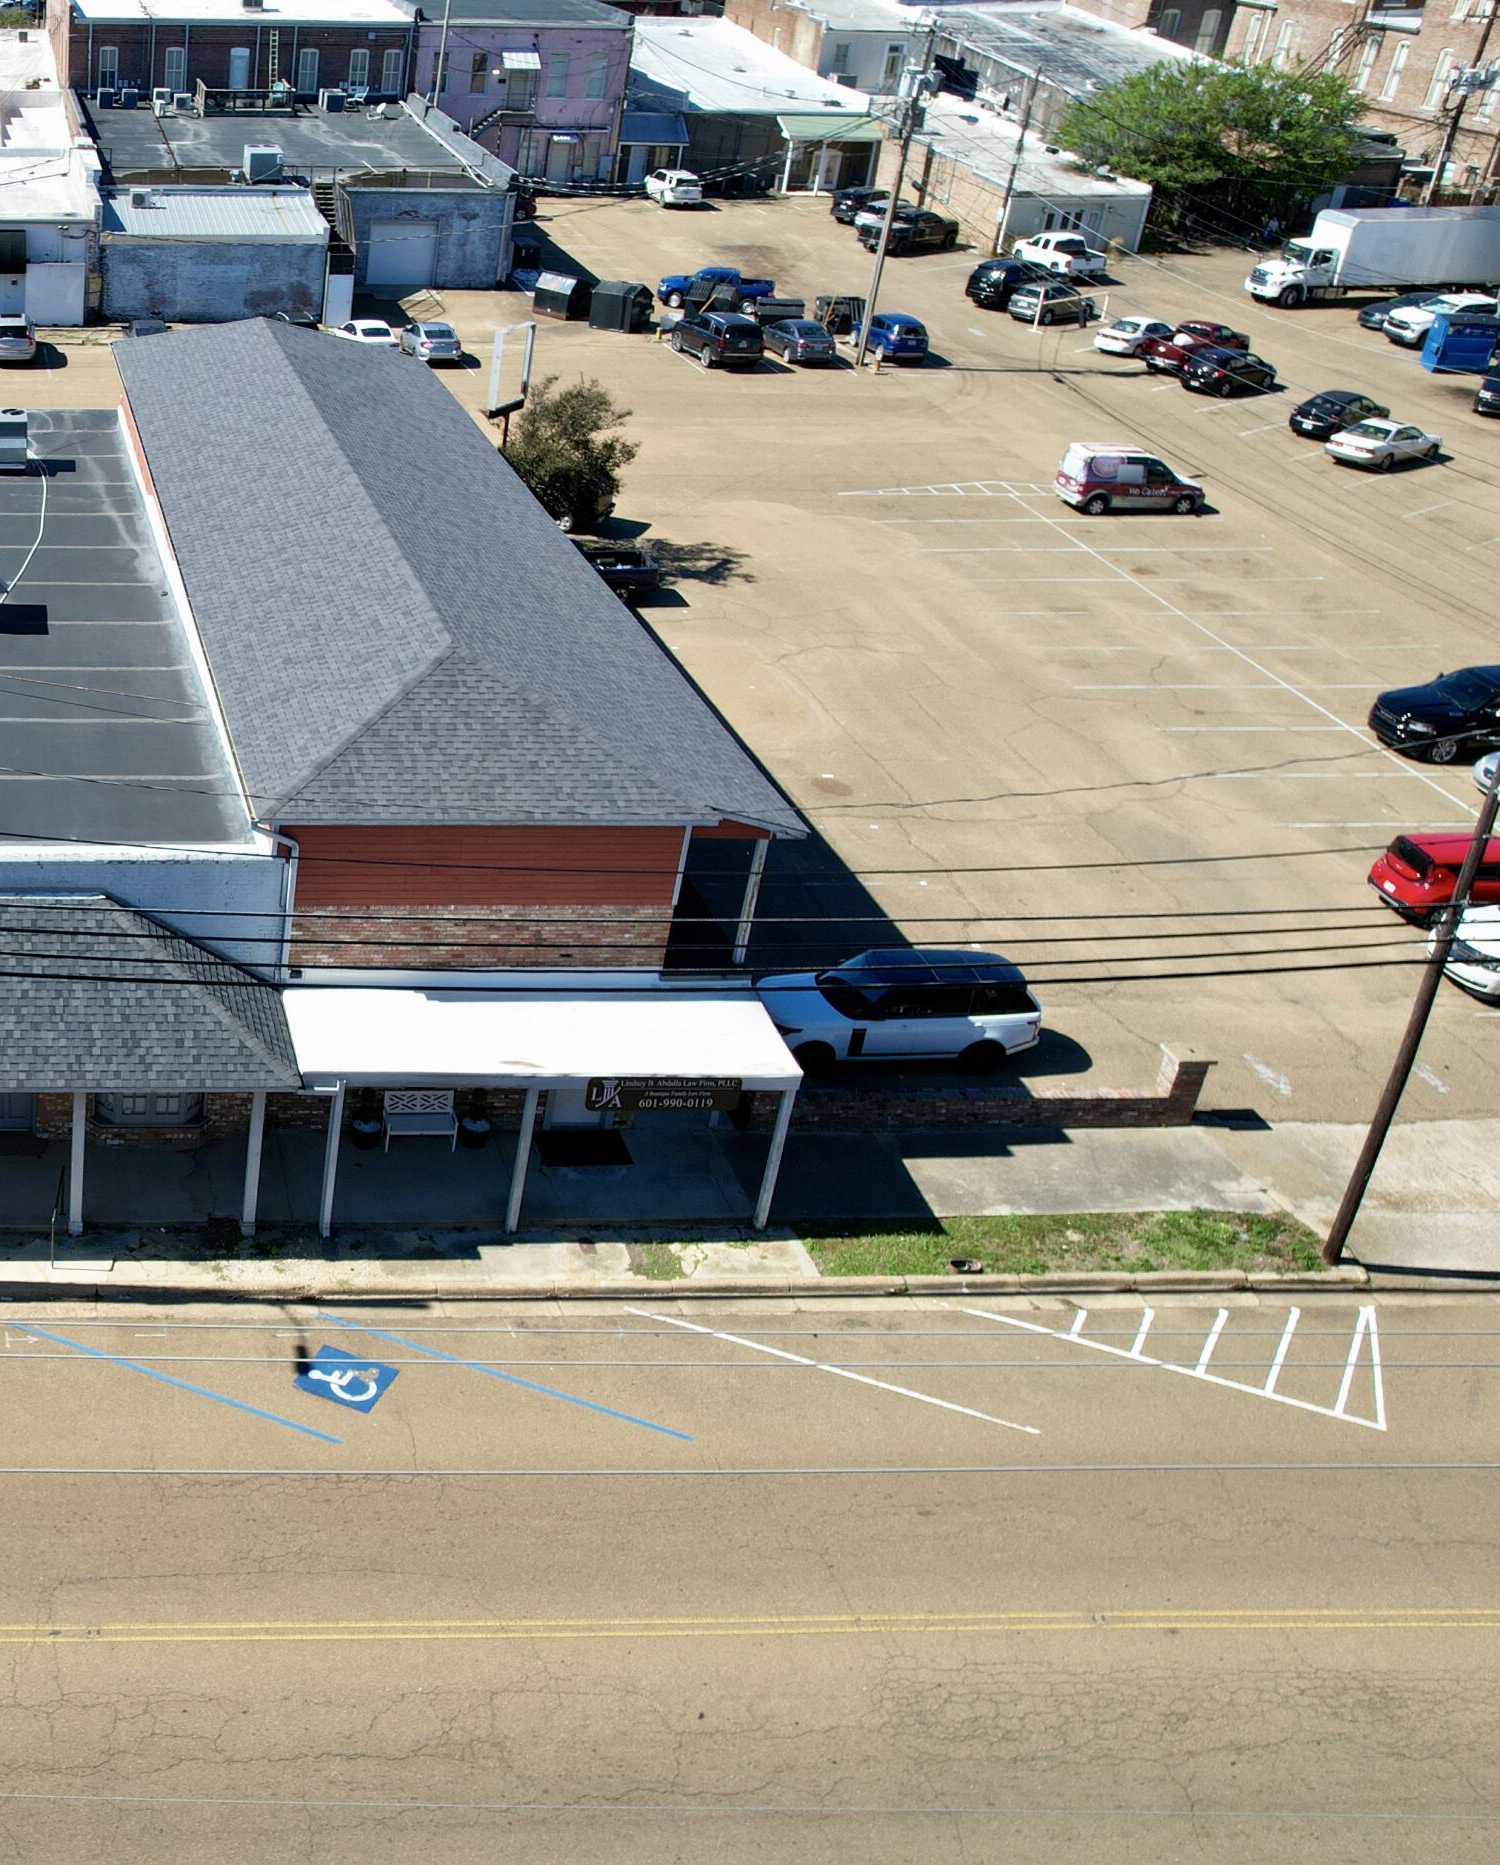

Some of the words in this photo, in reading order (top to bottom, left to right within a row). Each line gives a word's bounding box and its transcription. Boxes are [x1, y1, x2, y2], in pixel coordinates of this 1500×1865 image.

[620, 1079, 646, 1089] Lindsey
[656, 1079, 682, 1087] Abdalla
[683, 1079, 697, 1087] Law
[718, 1079, 739, 1087] PLLC
[638, 1098, 714, 1109] 601-990-0119
